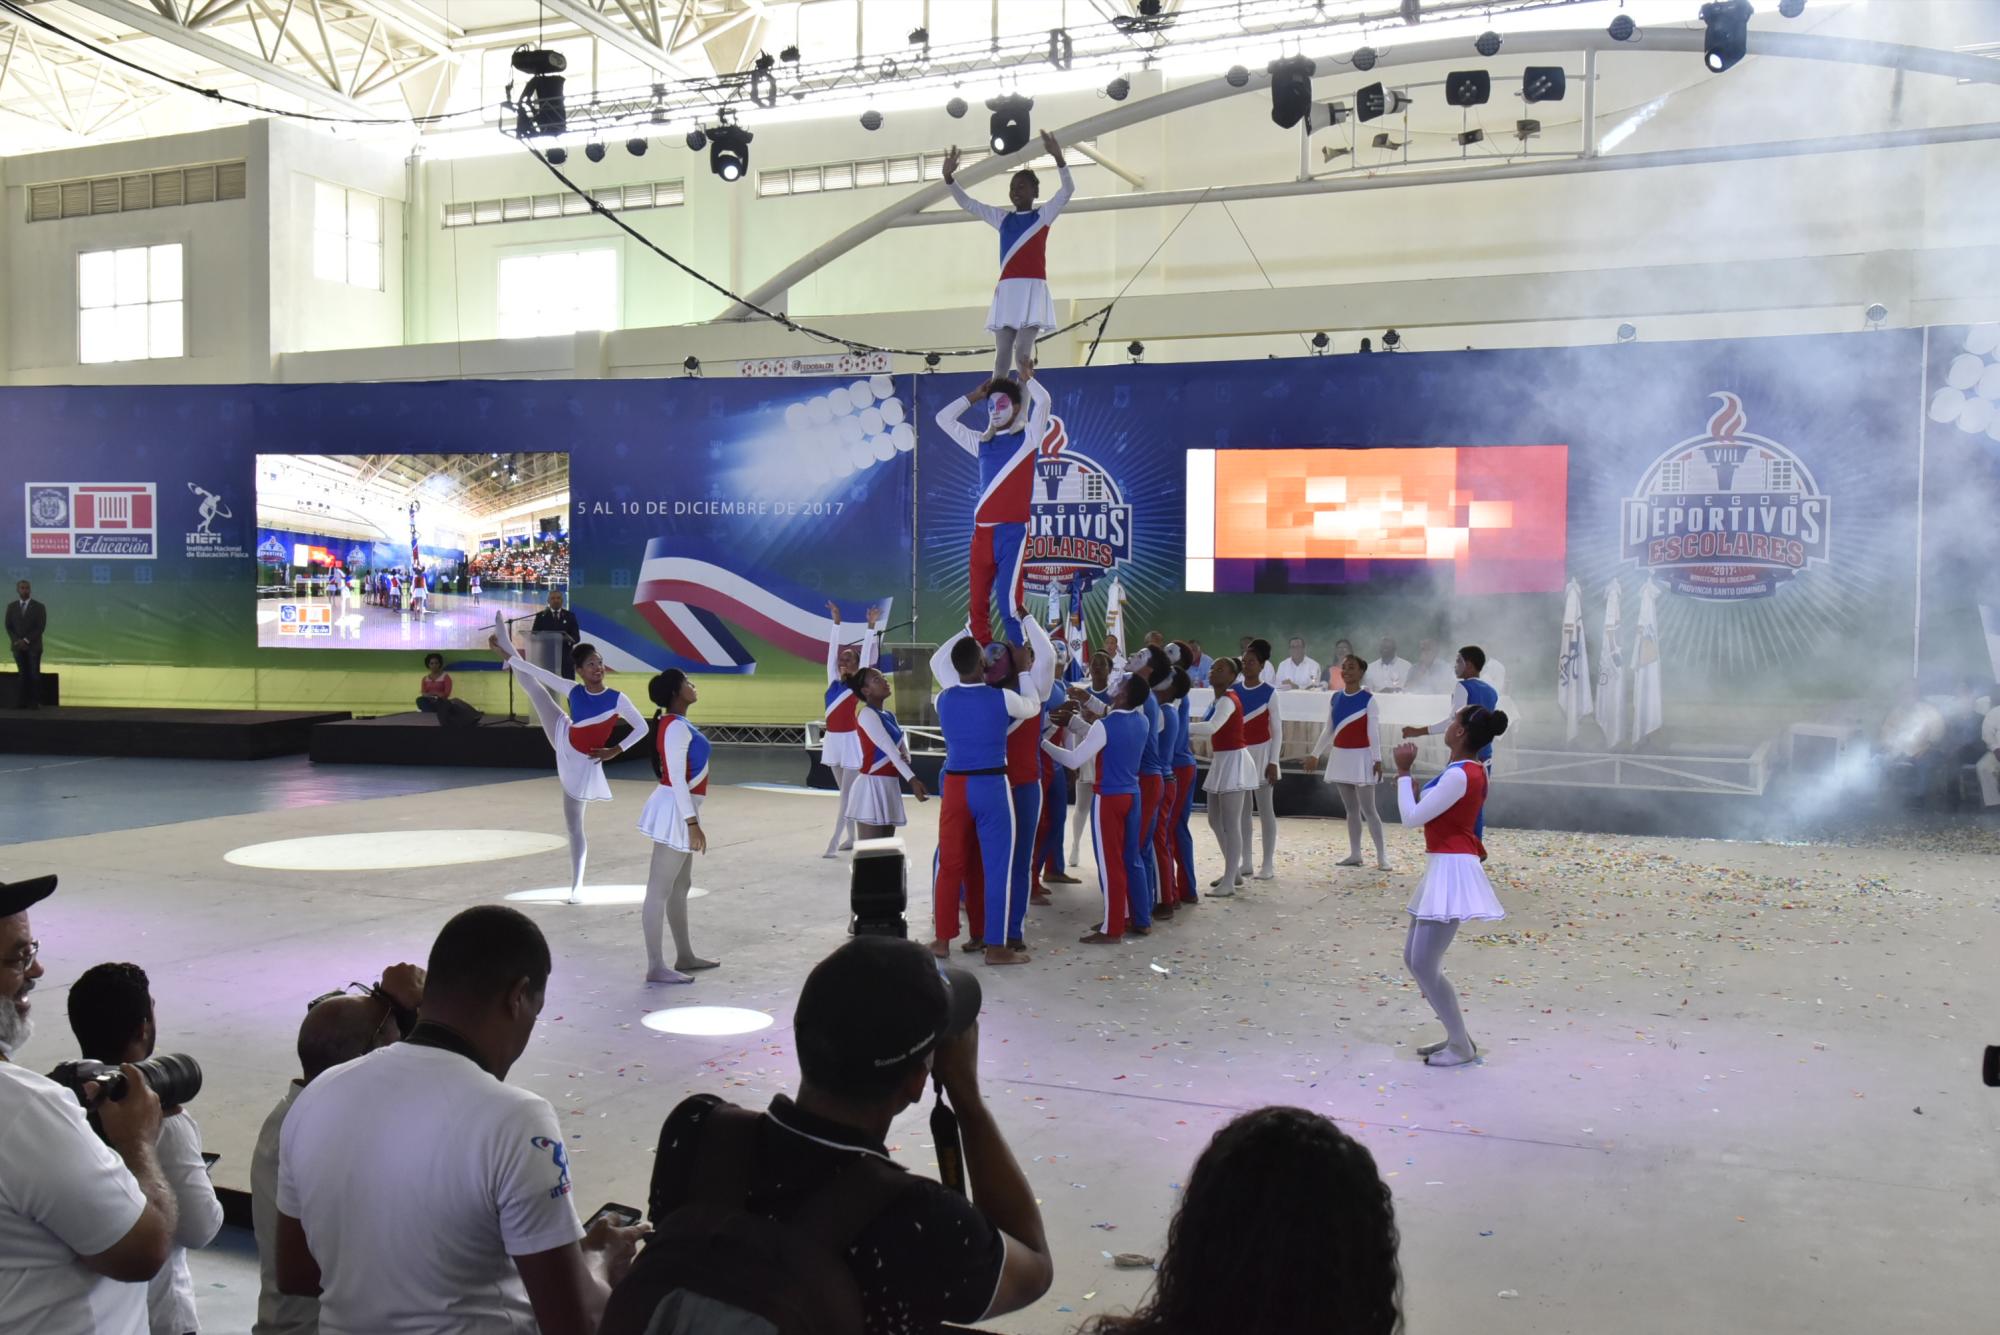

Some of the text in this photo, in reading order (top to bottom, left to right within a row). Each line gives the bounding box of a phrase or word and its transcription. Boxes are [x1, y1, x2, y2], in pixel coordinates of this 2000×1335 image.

[1713, 449, 1738, 462] VIII
[1043, 463, 1063, 477] VIII
[1651, 495, 1798, 506] JUEGOS
[577, 501, 845, 515] 5 AL 10 DE DICIEMBRE DE 2017
[1037, 504, 1108, 514] EGOS
[1028, 509, 1124, 547] ORTIVOS
[1629, 500, 1821, 546] DEPORTIVOS
[76, 535, 149, 553] Educación
[1024, 535, 1113, 567] COLARES
[1648, 532, 1804, 567] ESCOLARES
[1678, 583, 1767, 596] PROVINCIA SANTO DOMINGO
